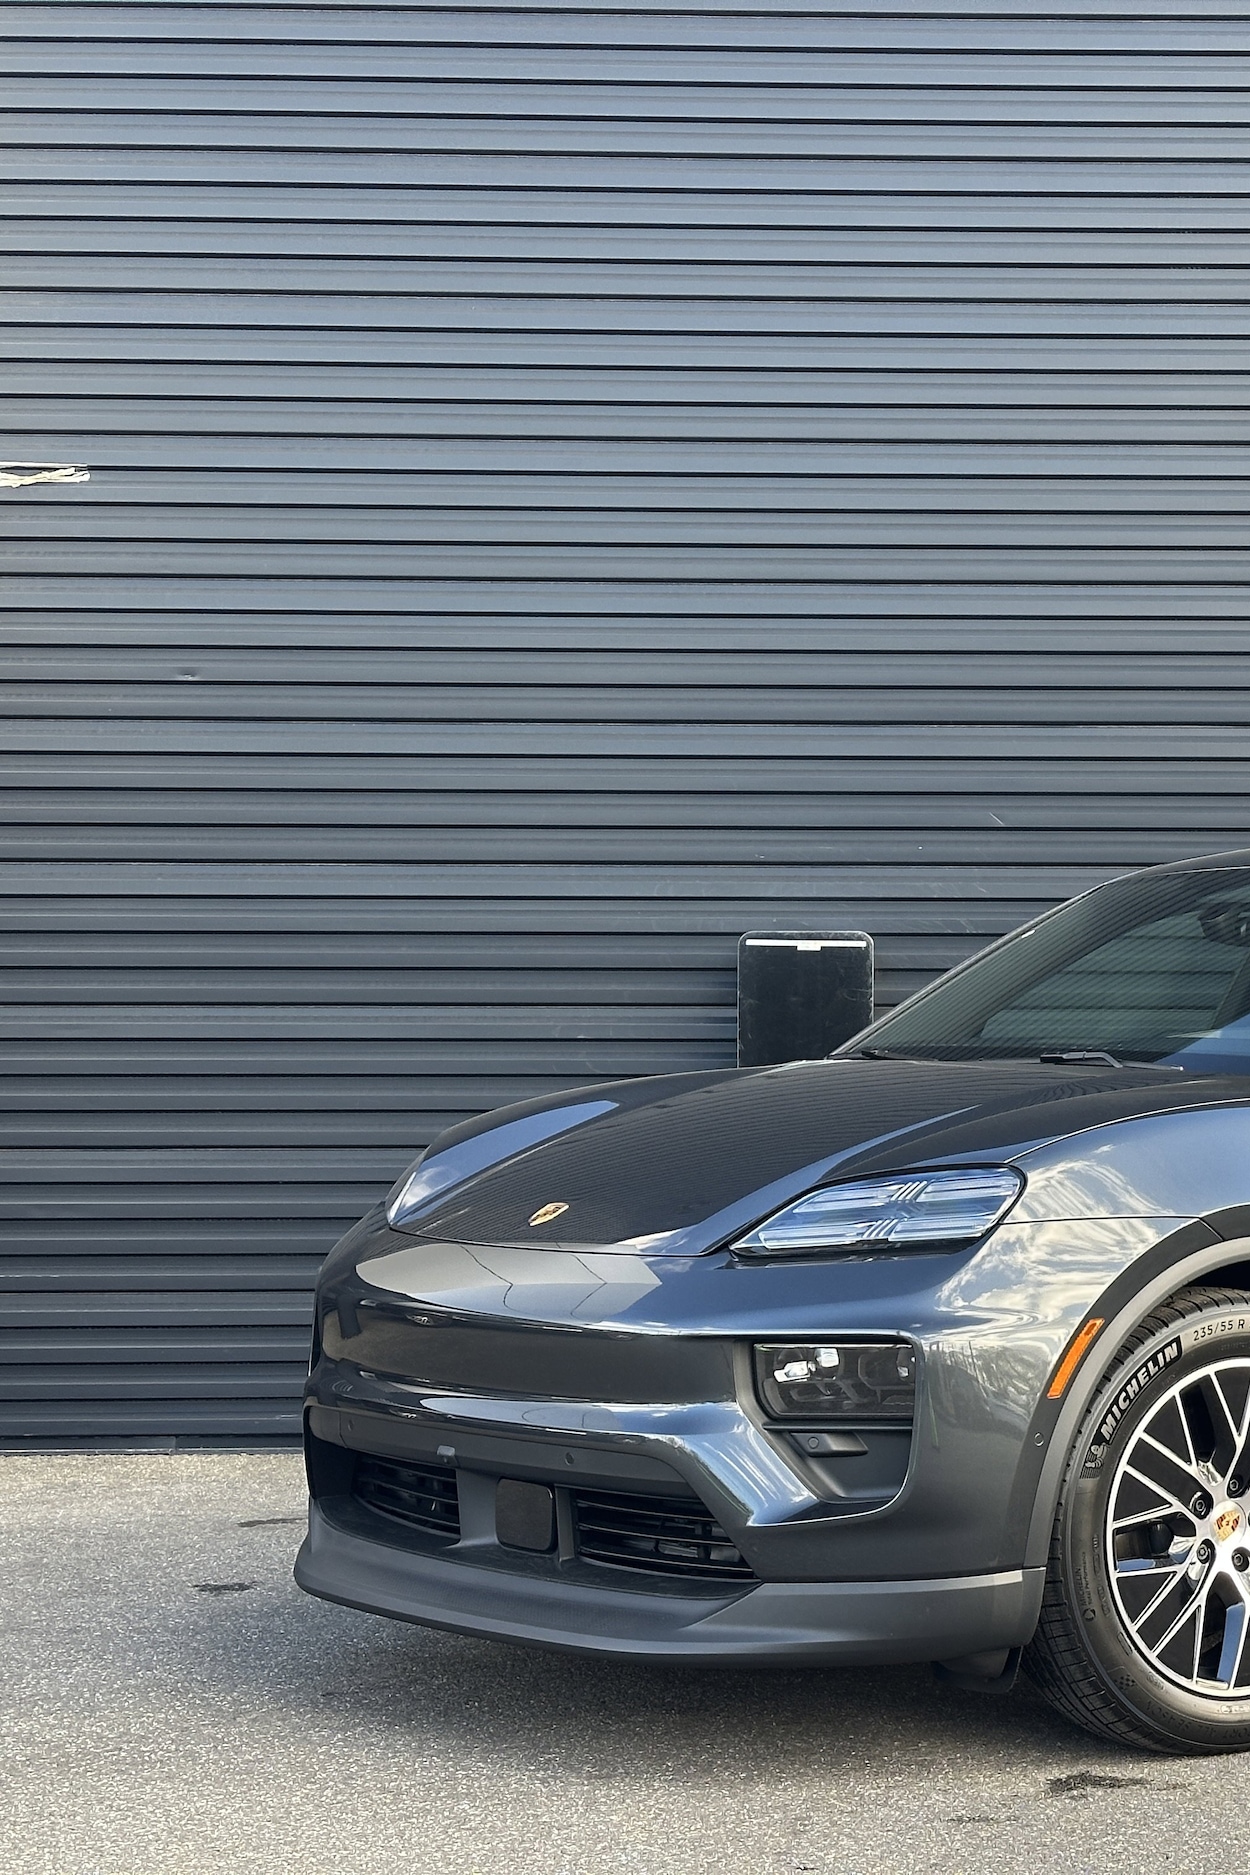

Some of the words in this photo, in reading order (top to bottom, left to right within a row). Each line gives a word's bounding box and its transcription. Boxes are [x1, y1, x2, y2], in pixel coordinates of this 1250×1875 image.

[1193, 1320, 1234, 1342] 235/55
[1237, 1319, 1246, 1330] R
[1100, 1341, 1180, 1441] MICHELIN
[1075, 1566, 1087, 1606] MICHELIN
